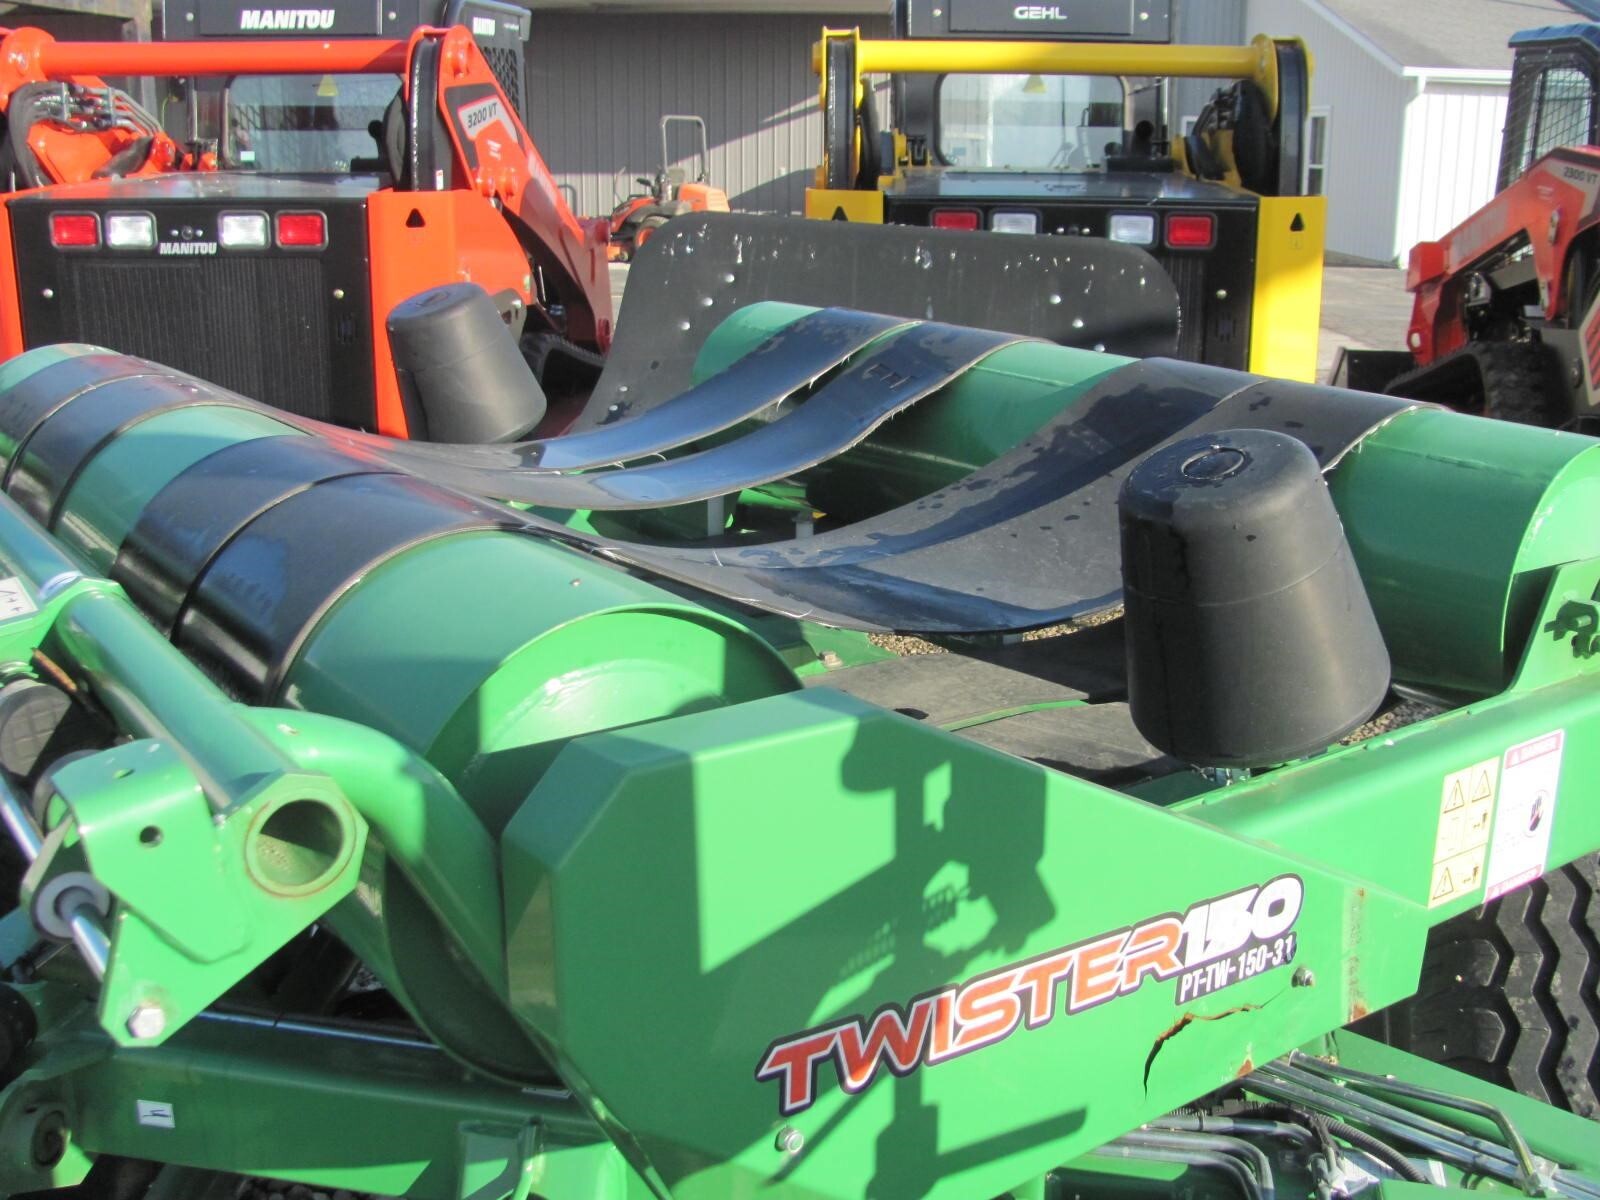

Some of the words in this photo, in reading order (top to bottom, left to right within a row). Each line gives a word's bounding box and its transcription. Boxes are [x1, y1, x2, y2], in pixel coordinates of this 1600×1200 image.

[240, 9, 336, 30] MANITOU
[1014, 6, 1068, 20] GEHL
[467, 107, 488, 129] 3200
[488, 102, 498, 118] VT
[159, 241, 218, 255] MANITOU
[1179, 933, 1294, 1003] PT-TW-150-31
[757, 911, 1184, 1114] TWISTER
